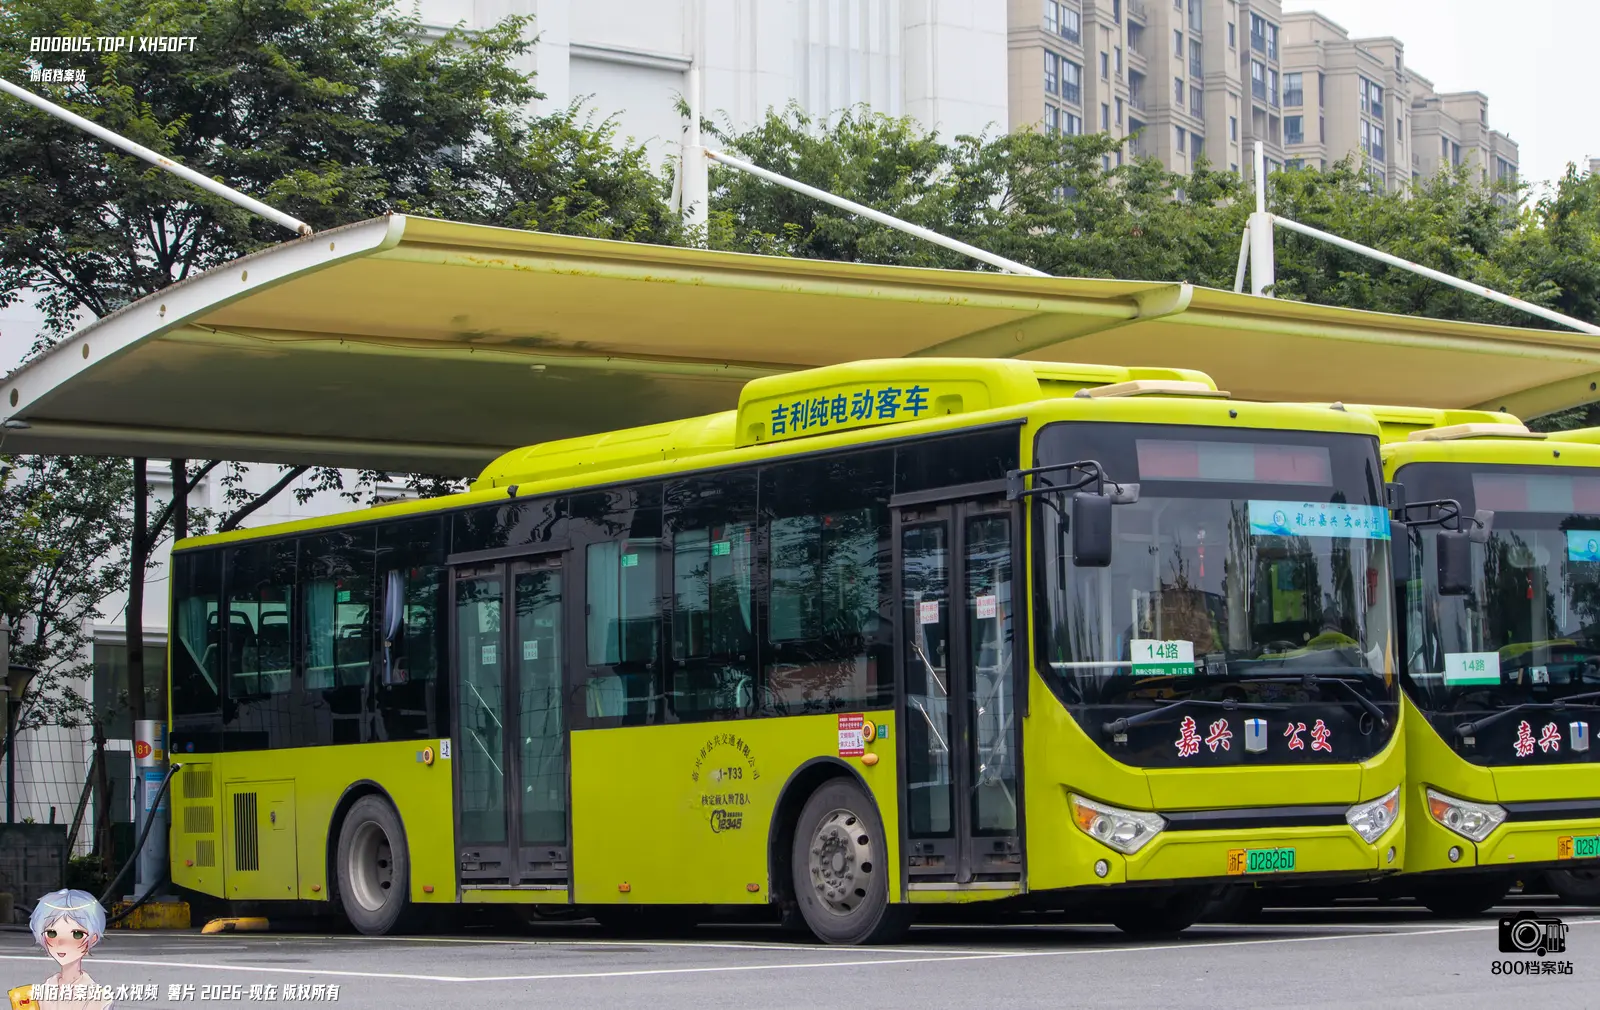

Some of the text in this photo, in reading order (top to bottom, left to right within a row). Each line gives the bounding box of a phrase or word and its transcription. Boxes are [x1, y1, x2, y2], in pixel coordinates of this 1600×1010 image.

[771, 385, 930, 436] 吉利纯电动客车
[1147, 643, 1179, 659] 14路
[1462, 659, 1485, 671] 14路
[1175, 716, 1332, 757] 嘉兴 公交
[1513, 720, 1561, 757] 嘉兴
[136, 744, 149, 755] 81
[718, 818, 743, 830] 12345
